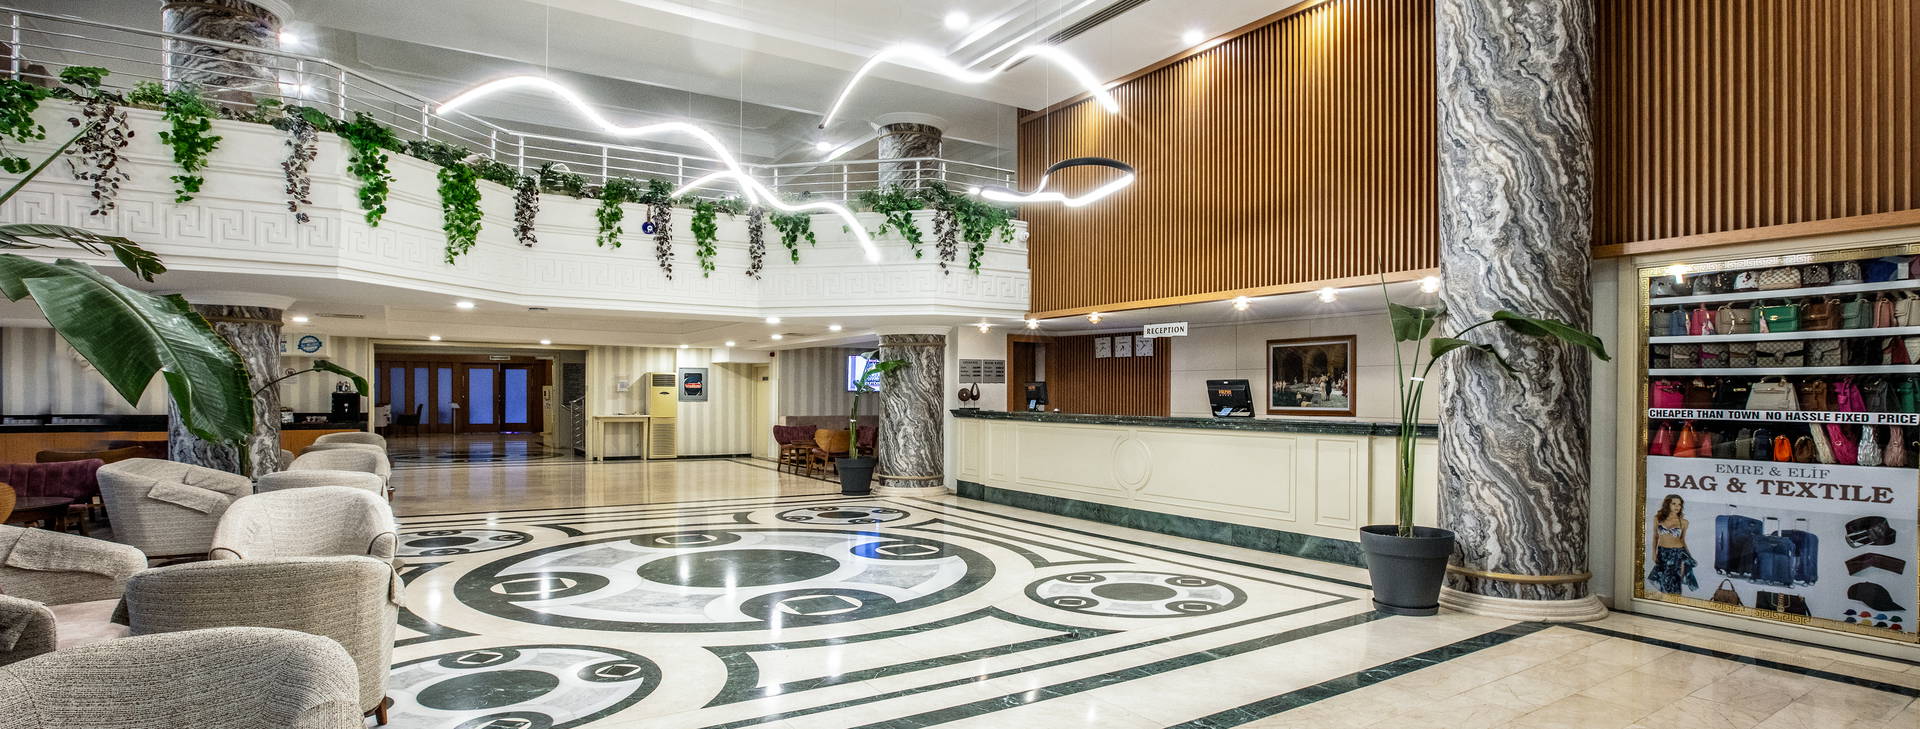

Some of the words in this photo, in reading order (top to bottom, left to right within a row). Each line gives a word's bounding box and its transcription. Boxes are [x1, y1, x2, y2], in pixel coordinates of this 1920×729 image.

[1146, 326, 1185, 335] RECEPTION
[1649, 409, 1694, 418] CHEAPER
[1697, 410, 1724, 419] THAN
[1728, 410, 1760, 420] TOWN
[1765, 411, 1782, 421] NO
[1785, 412, 1831, 421] HASSLE
[1834, 413, 1870, 423] FIXED
[1877, 414, 1918, 424] PRICE
[1715, 463, 1764, 476] EMRE
[1768, 466, 1782, 477] &
[1663, 473, 1718, 492] BAG
[1726, 477, 1747, 494] &
[1756, 479, 1895, 504] TEXTILE
